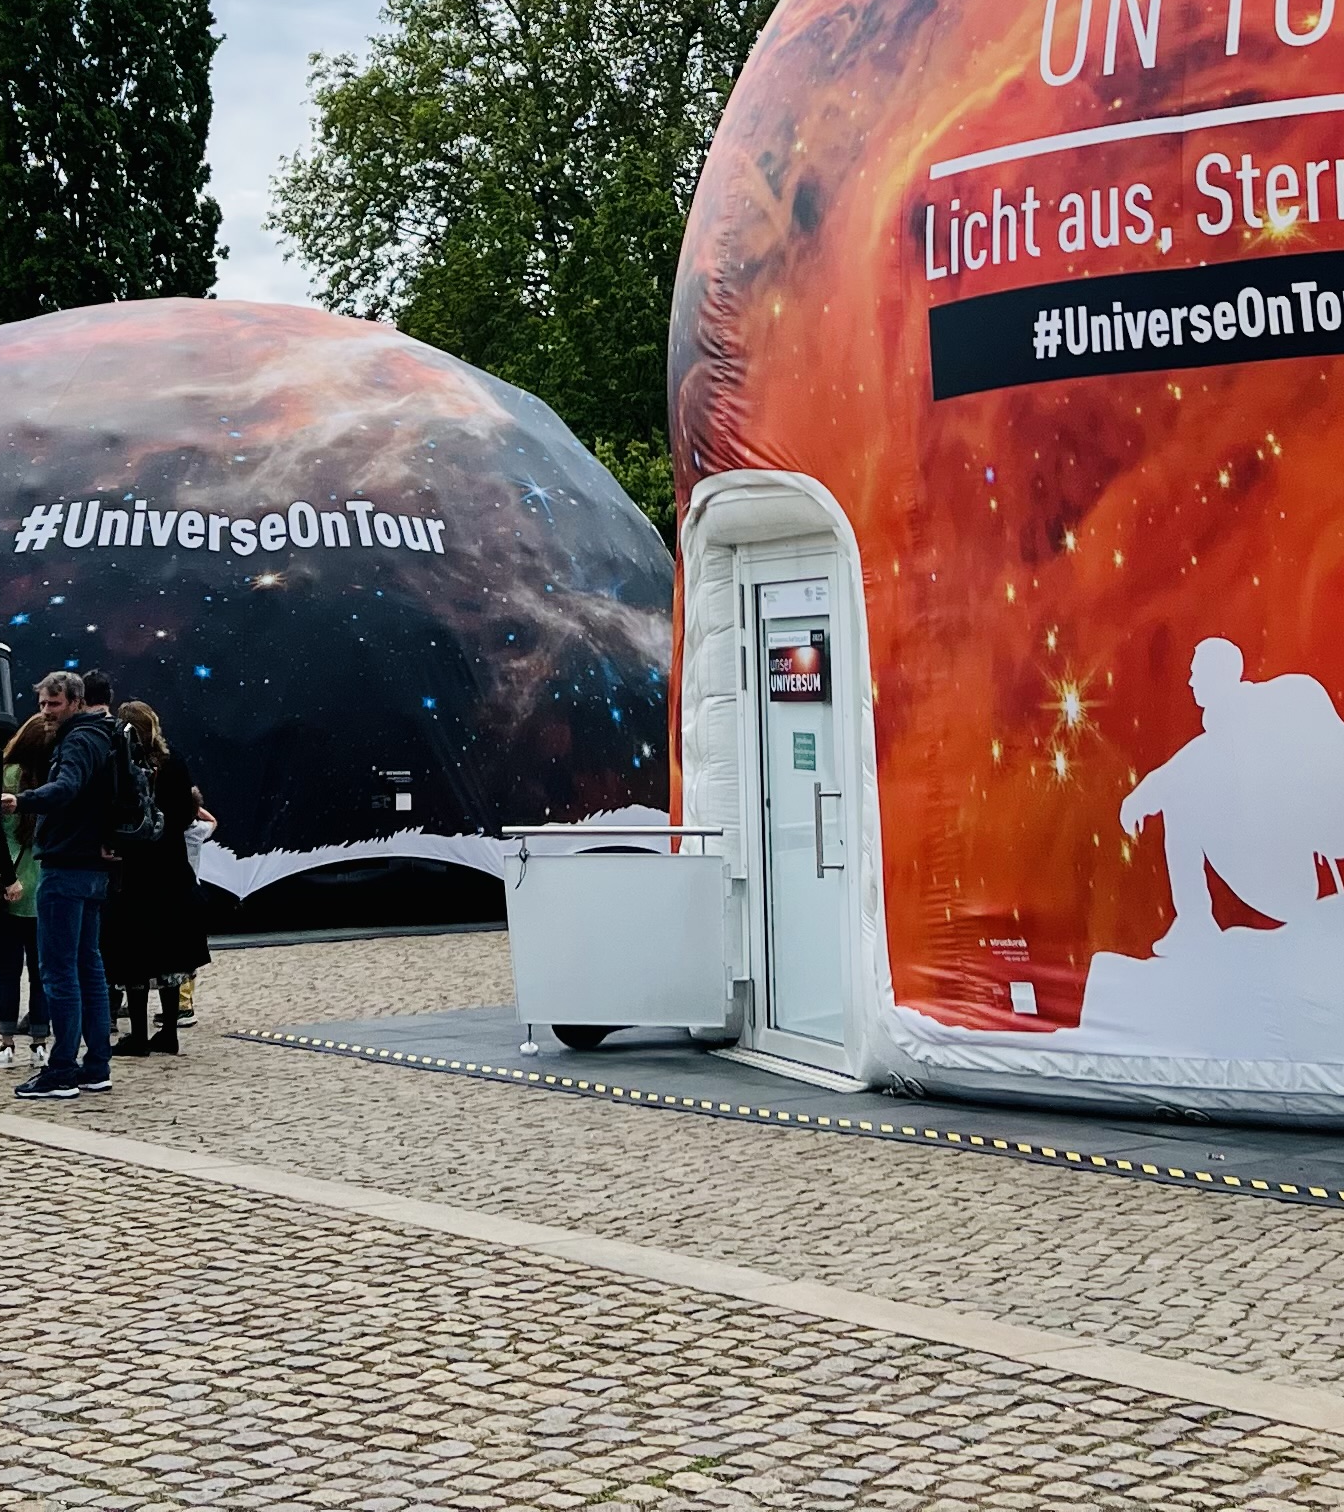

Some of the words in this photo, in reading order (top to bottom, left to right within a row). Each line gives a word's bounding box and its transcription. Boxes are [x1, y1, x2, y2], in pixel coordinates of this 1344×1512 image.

[924, 183, 1040, 281] Licht
[1058, 182, 1174, 255] aus,
[13, 499, 445, 555] #UniverseOnTour
[770, 657, 793, 672] unser
[770, 672, 821, 692] UNIVERSUM
